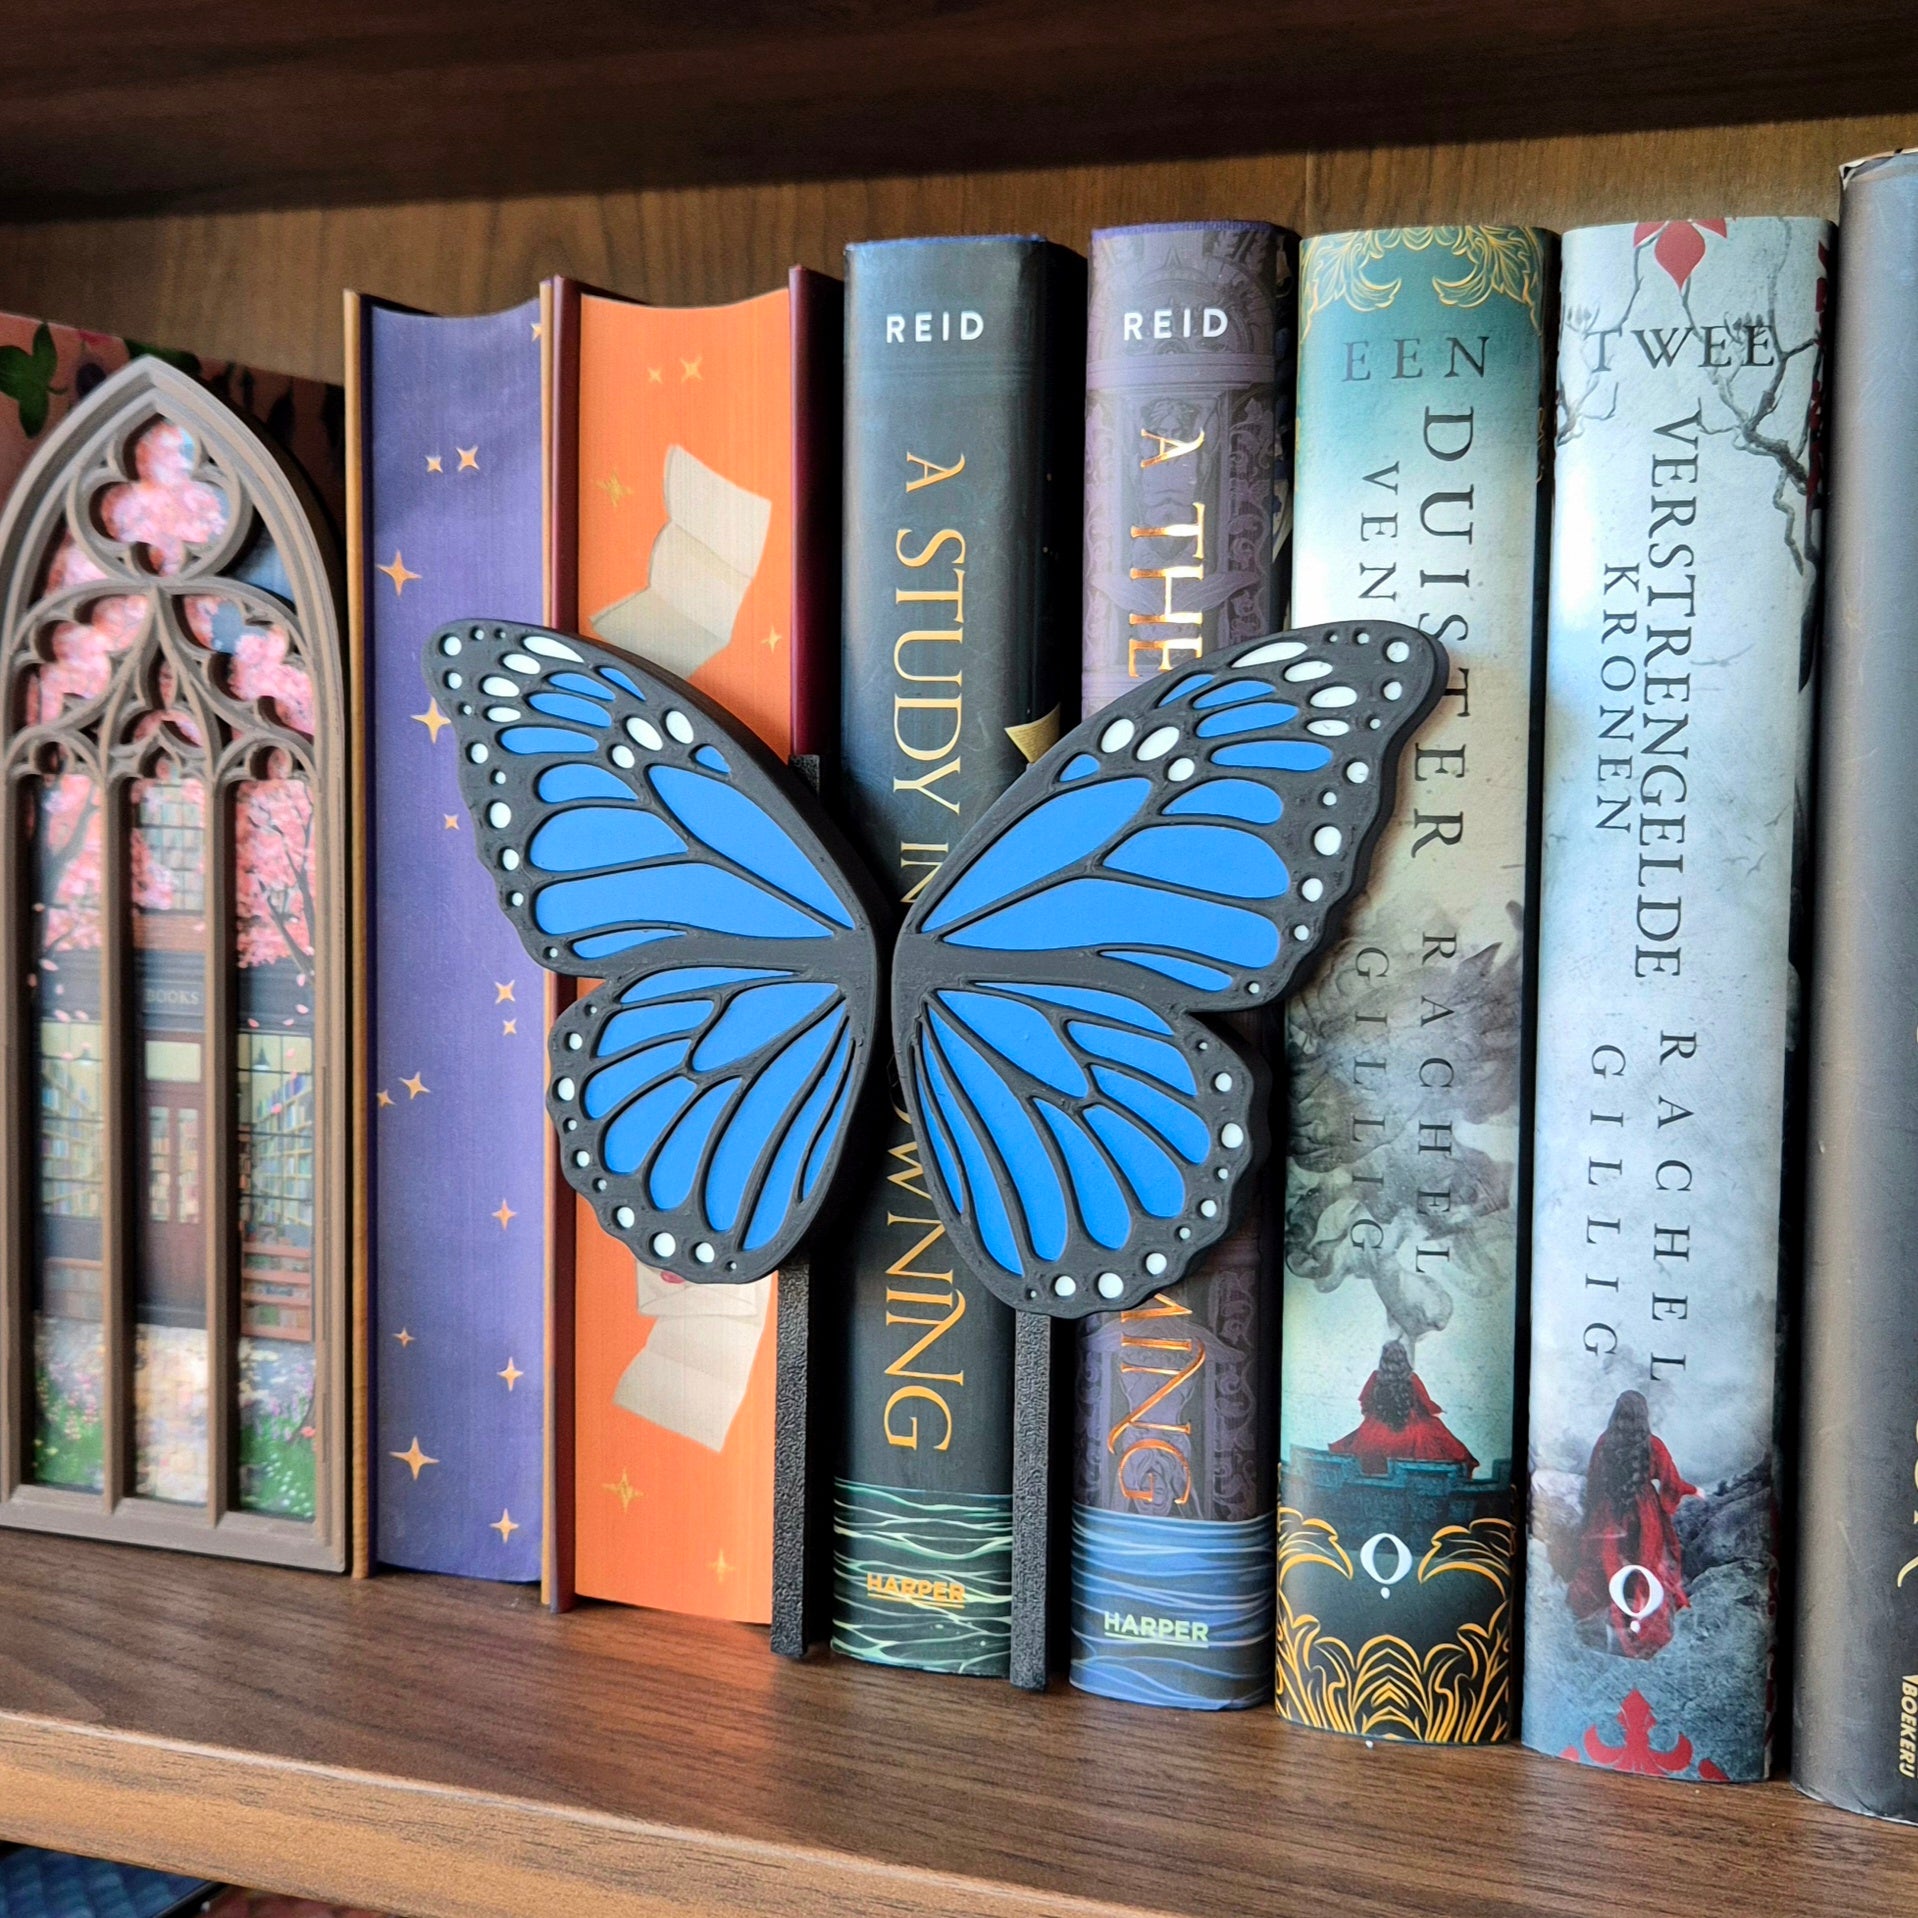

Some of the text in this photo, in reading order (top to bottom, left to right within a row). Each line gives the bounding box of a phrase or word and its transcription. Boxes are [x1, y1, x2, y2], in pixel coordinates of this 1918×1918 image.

[886, 310, 984, 343] REID
[1124, 308, 1228, 340] REID
[1342, 335, 1490, 382] EEN
[1590, 324, 1777, 373] TWEE
[905, 451, 966, 493] A
[1140, 427, 1205, 468] A
[892, 528, 966, 816] STUDY
[1412, 406, 1474, 859] DUISTER
[1595, 562, 1641, 835] KRONEN
[1635, 413, 1702, 978] VERSTRENGELDE
[1350, 946, 1390, 1251] GILLIG
[1415, 932, 1457, 1274] RACHEL
[1582, 1044, 1627, 1356] GILLIG
[1649, 1030, 1697, 1382] RACHEL
[867, 1572, 965, 1603] HARPER
[1104, 1611, 1209, 1643] HARPER
